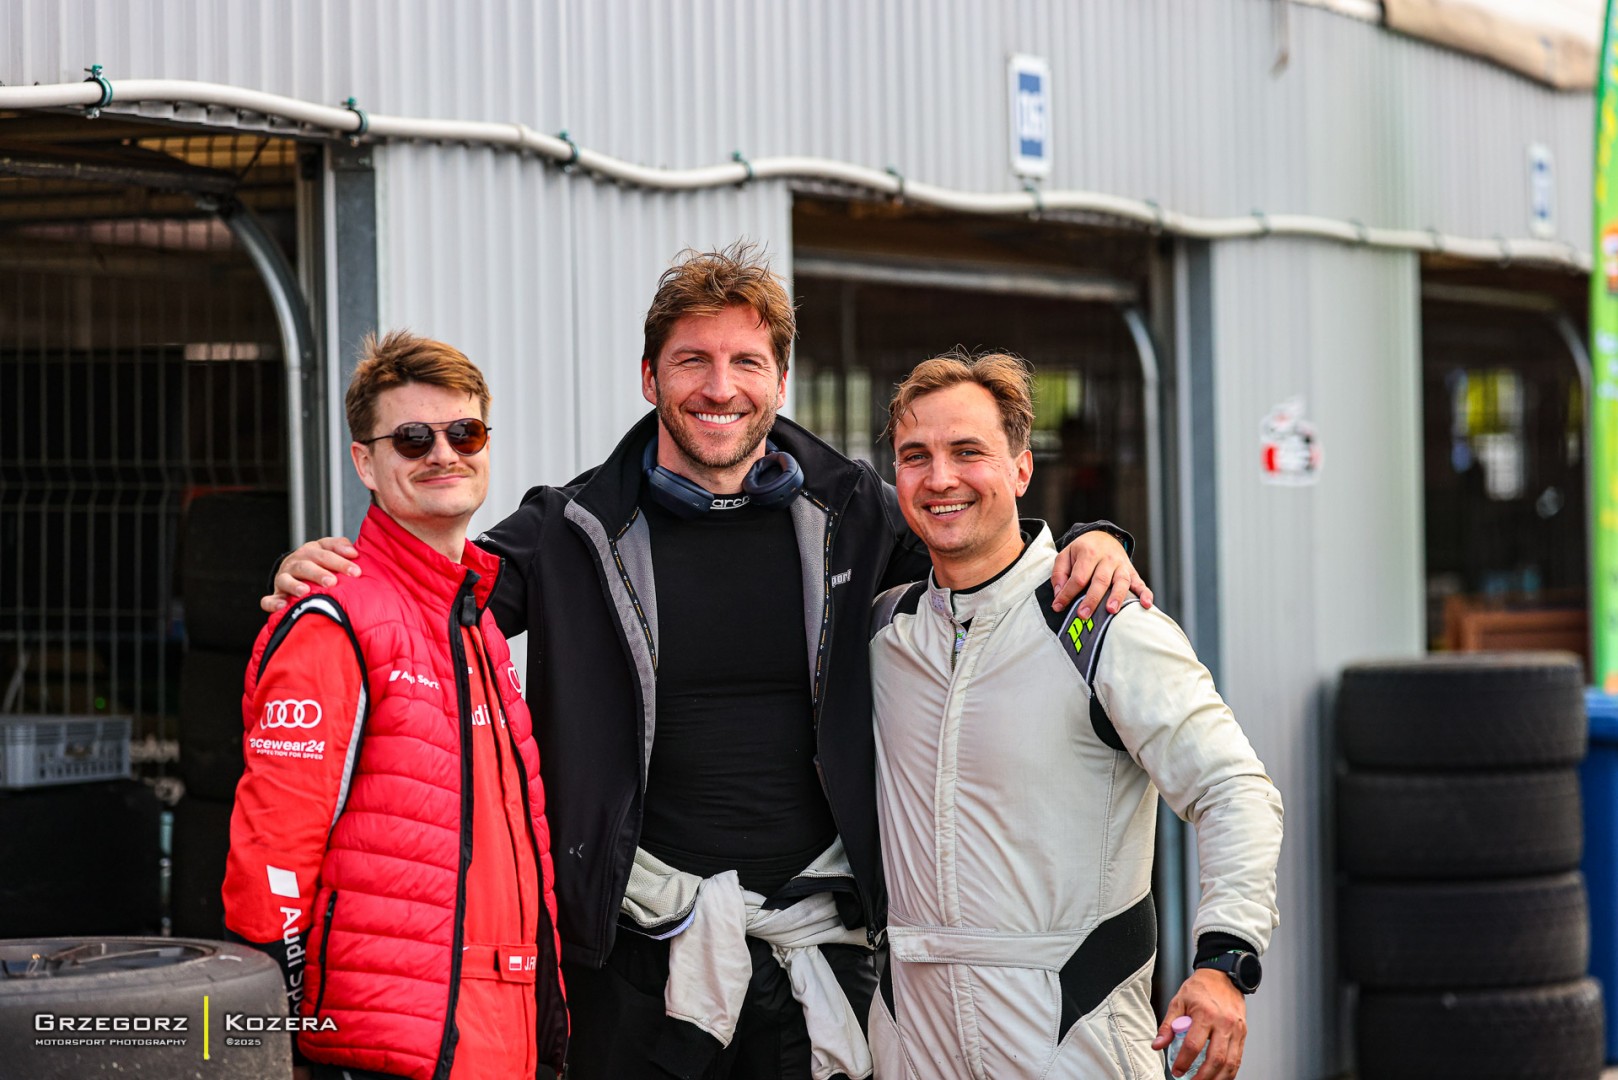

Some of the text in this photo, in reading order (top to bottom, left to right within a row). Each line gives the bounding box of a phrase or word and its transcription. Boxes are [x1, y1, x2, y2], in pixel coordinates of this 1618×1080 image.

[711, 496, 750, 509] arco
[832, 569, 851, 588] port
[249, 738, 325, 753] acewear24
[280, 906, 306, 968] Audi
